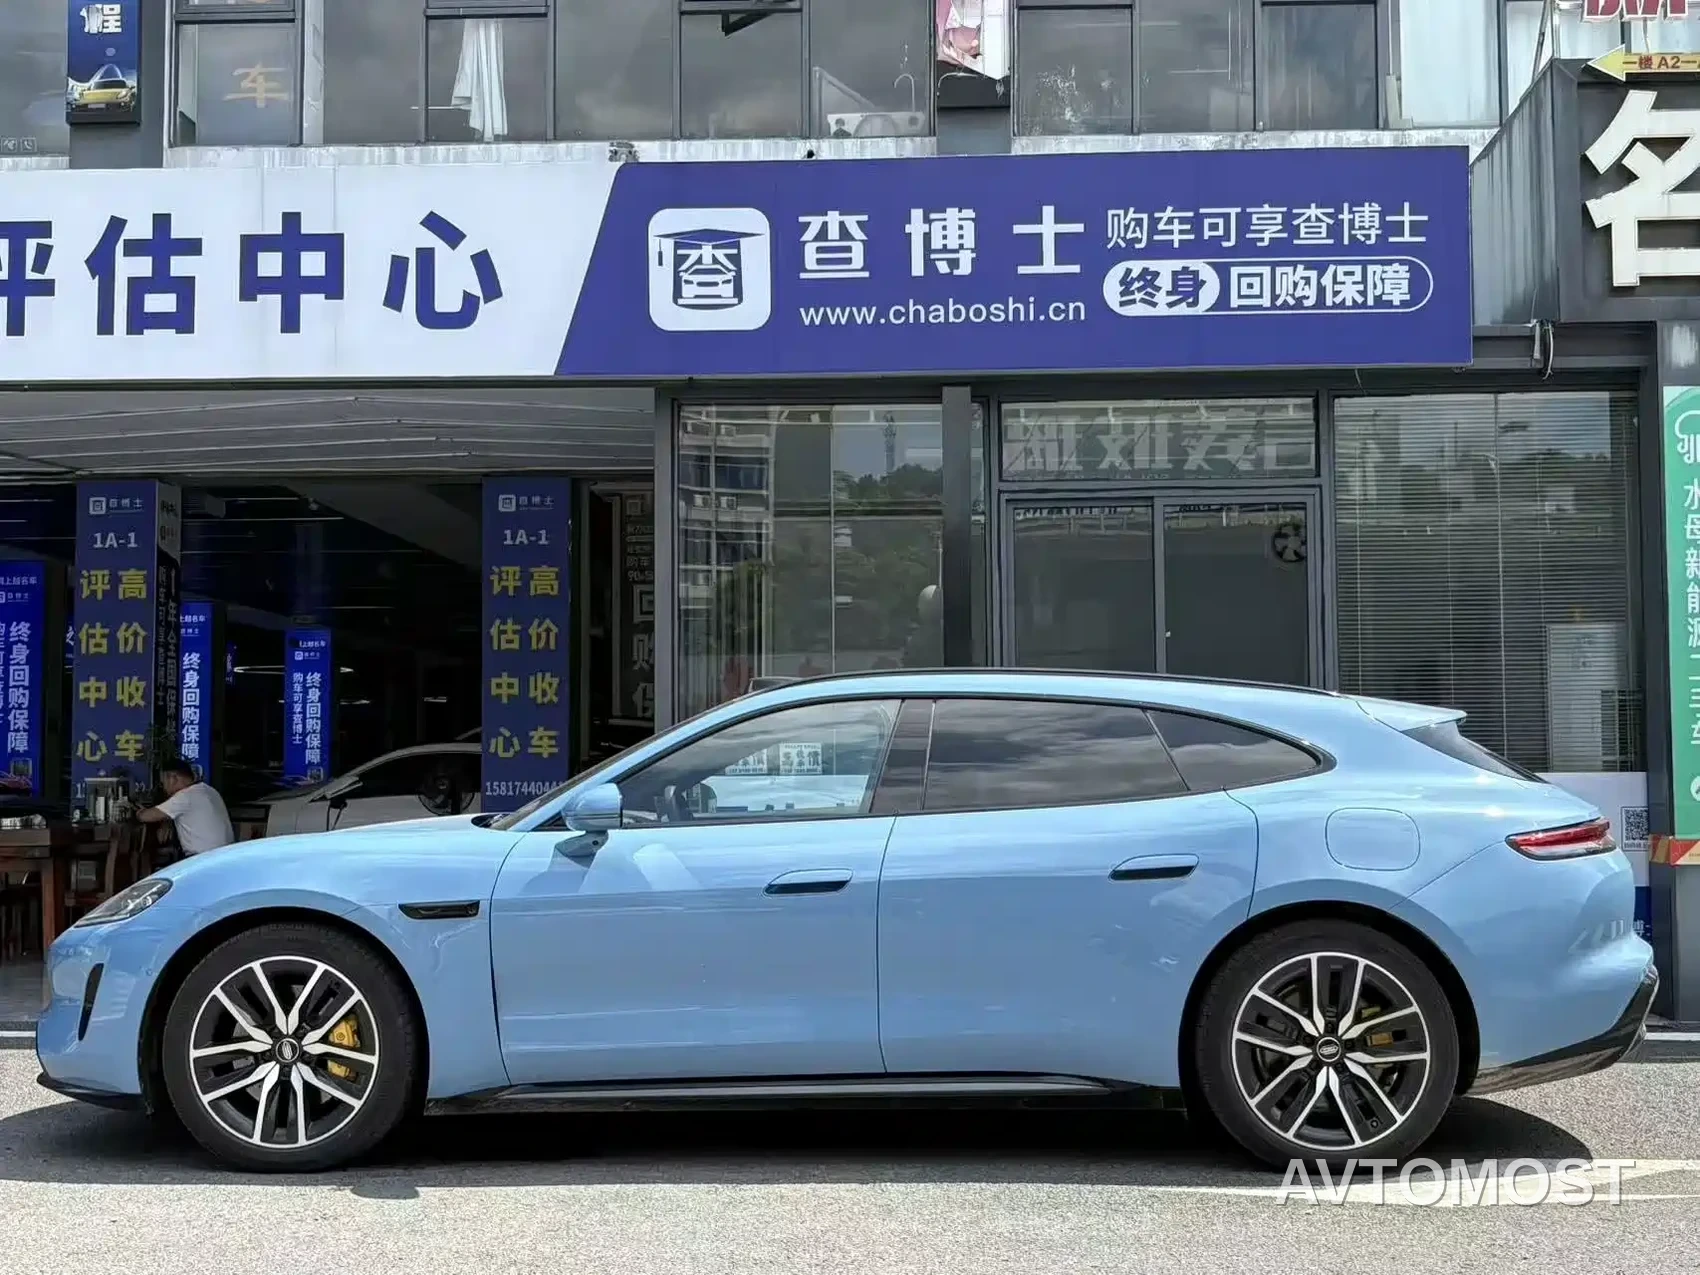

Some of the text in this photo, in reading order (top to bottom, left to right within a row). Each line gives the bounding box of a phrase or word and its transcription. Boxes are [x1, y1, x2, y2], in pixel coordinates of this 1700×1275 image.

[798, 205, 1085, 279] 查博士
[1106, 201, 1429, 249] 购车可享查博士
[799, 296, 1086, 326] www.chaboshi.cn
[1117, 262, 1411, 310] 终身 回购保障
[93, 532, 138, 549] 1A-1
[503, 529, 549, 545] 1A-1
[7, 621, 31, 754] 终身回购保障
[77, 569, 111, 763] 评估中心
[114, 568, 148, 761] 高价收车
[181, 652, 201, 760] 终身回购保障
[489, 565, 523, 760] 评估中心
[528, 565, 560, 758] 高价收车
